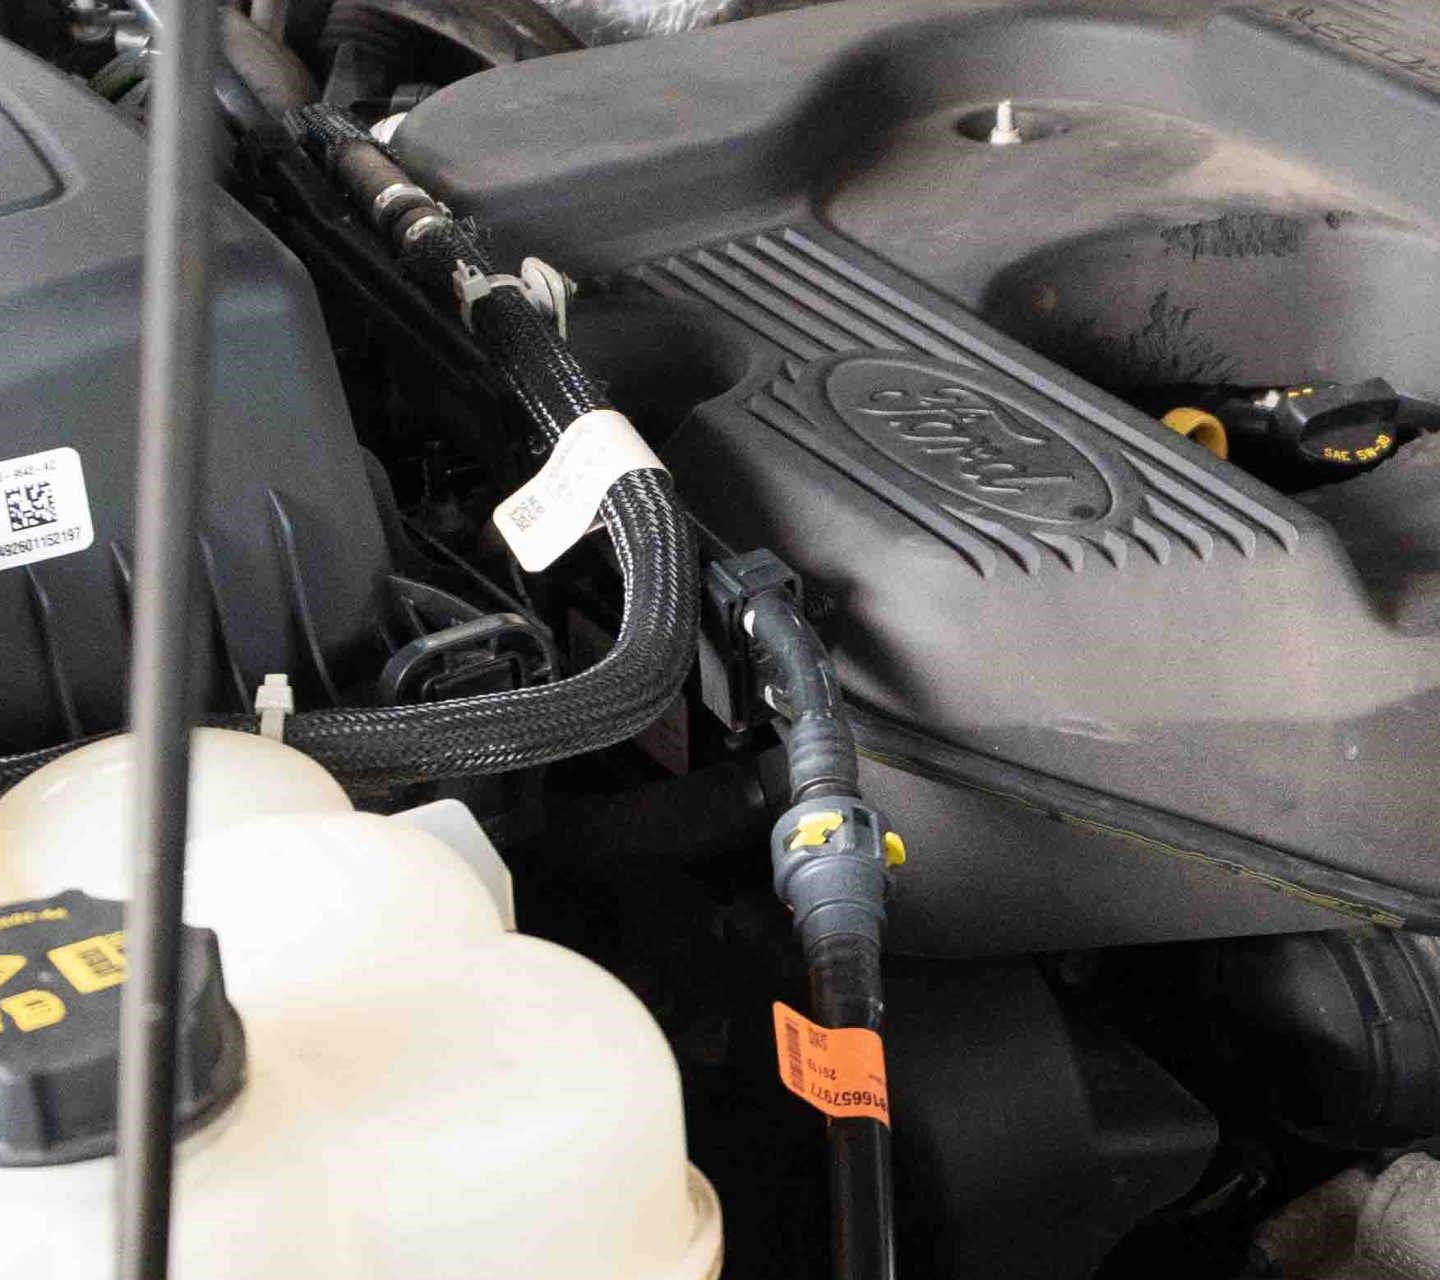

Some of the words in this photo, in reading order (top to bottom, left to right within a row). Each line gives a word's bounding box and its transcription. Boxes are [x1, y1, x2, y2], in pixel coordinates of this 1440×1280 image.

[858, 387, 1075, 495] Ford
[1323, 447, 1351, 462] SAE
[1356, 434, 1392, 461] 5W-30
